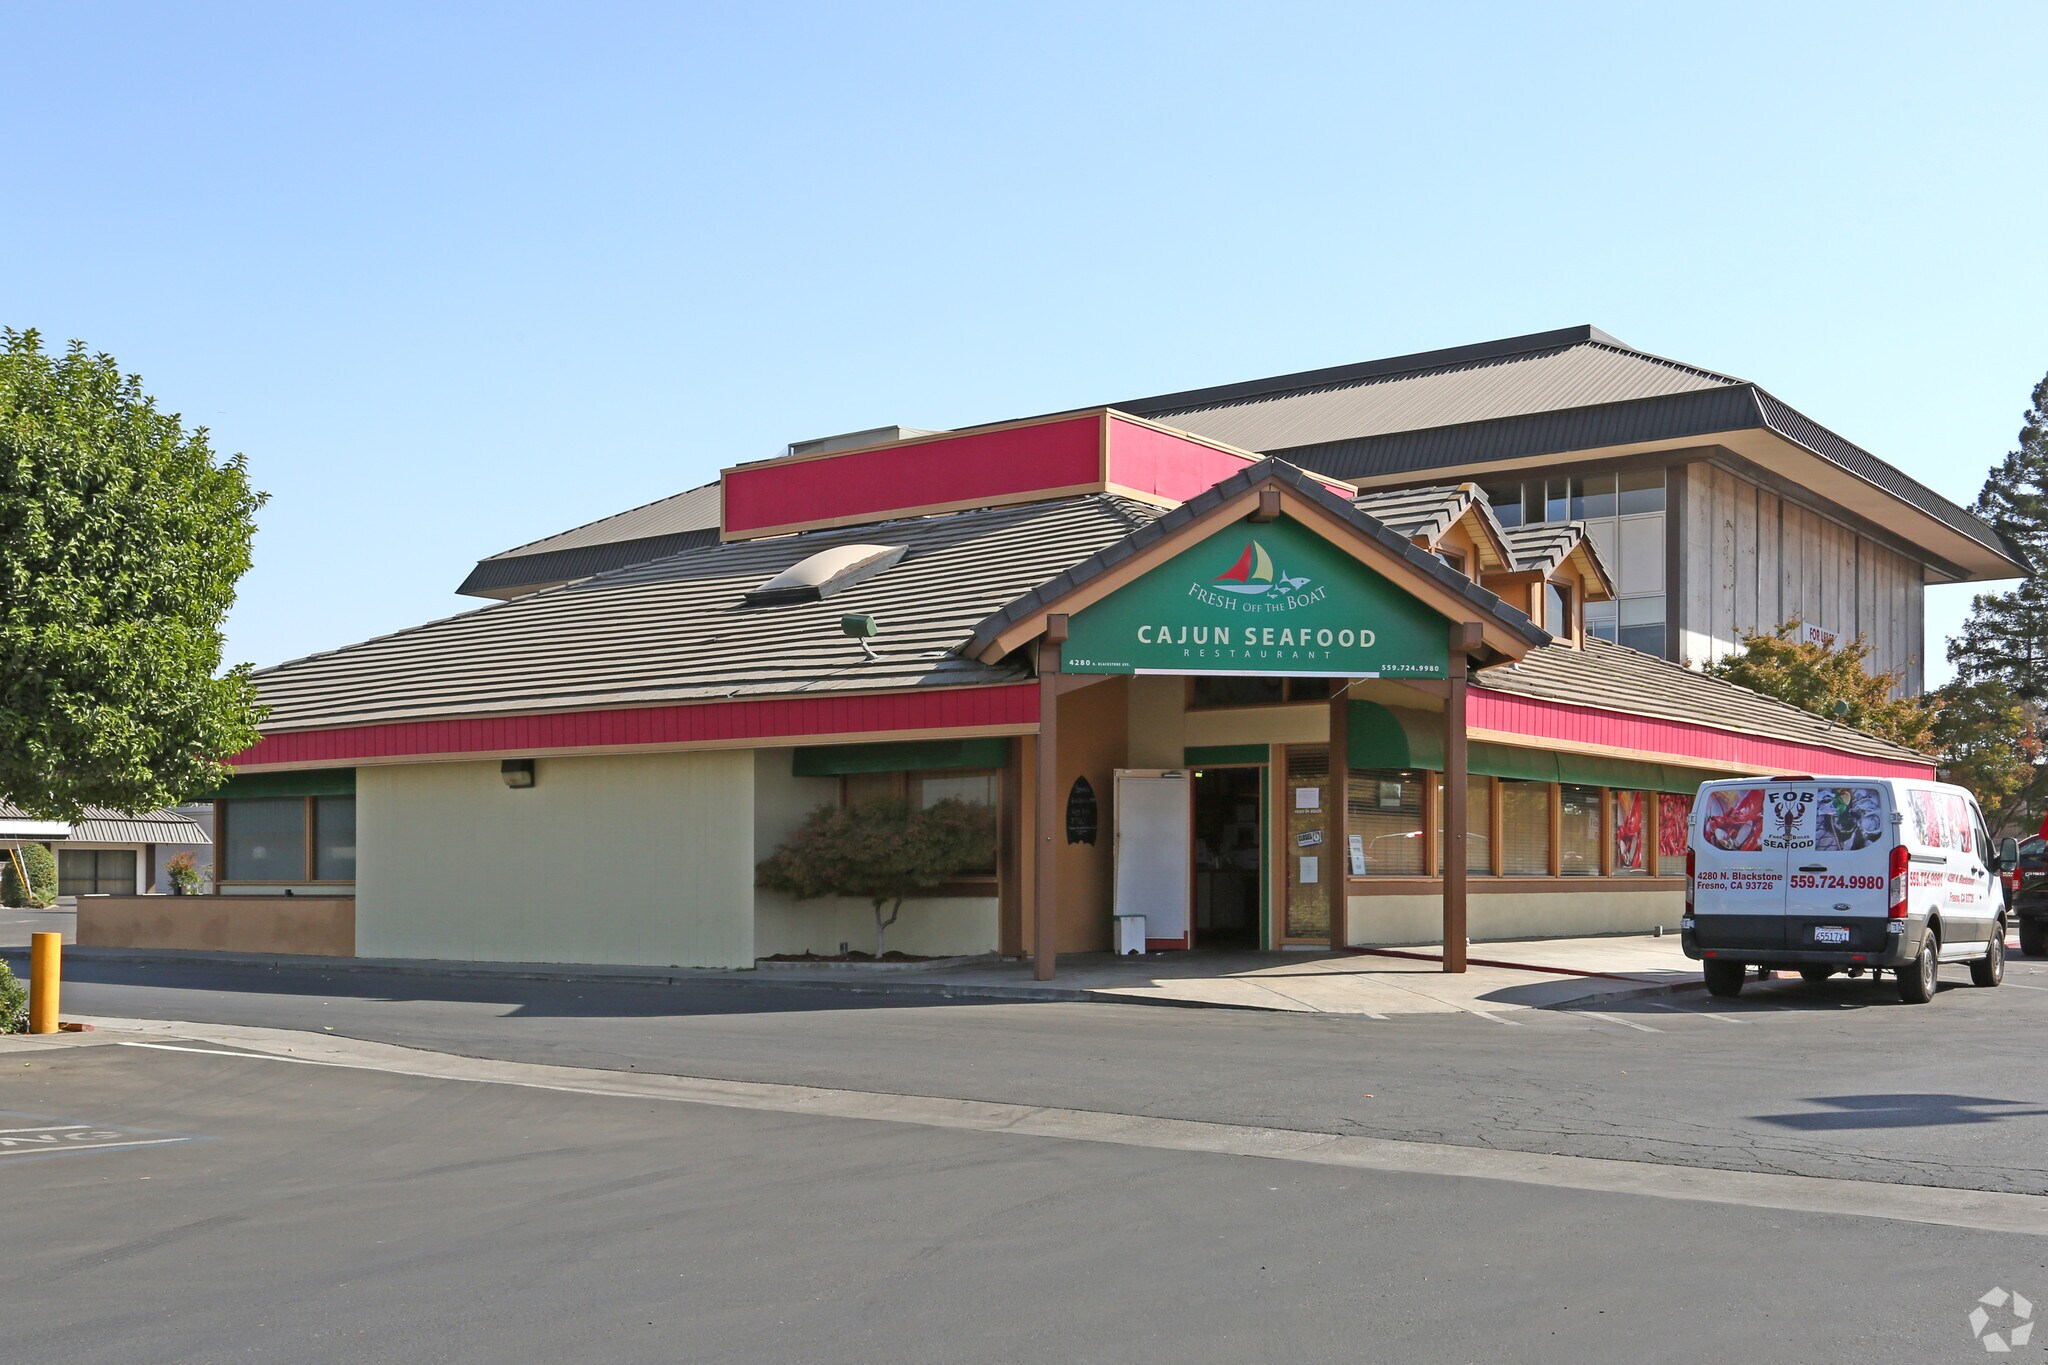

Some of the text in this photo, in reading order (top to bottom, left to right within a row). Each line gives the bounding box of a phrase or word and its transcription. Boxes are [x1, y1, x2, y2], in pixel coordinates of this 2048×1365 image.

[1188, 582, 1327, 612] FRESH OFF THE BOAT
[1137, 625, 1376, 648] CAJUN SEAFOOD
[1810, 627, 1820, 641] FOR
[1184, 649, 1330, 659] RESTAURANT
[1381, 664, 1440, 672] 559.724.9980
[1768, 791, 1815, 804] FOB
[1763, 839, 1814, 849] SEAFOOD
[1697, 872, 1783, 881] 4280 N. Blackstone
[1697, 882, 1774, 891] Fresno, CA 93726
[1790, 875, 1884, 890] 559.724.9980
